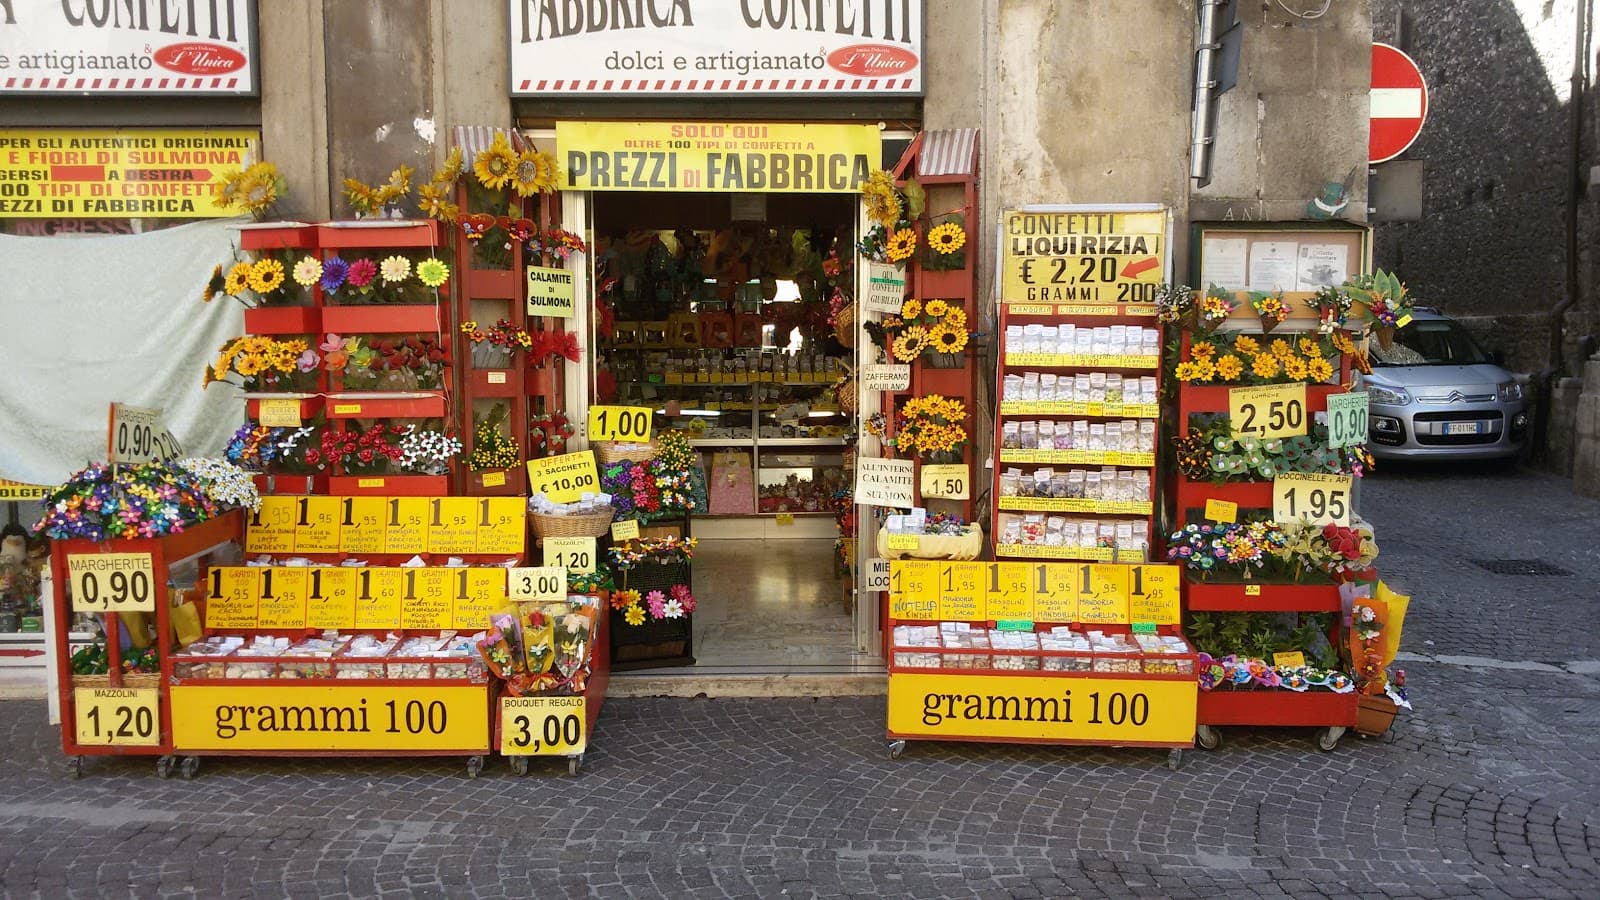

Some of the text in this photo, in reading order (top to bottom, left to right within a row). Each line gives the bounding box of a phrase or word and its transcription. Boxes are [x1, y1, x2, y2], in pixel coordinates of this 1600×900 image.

[18, 50, 153, 75] artigianato
[165, 50, 235, 68] L'Unica
[605, 50, 825, 75] dolci e artigianato
[839, 52, 906, 69] L'Unica
[671, 125, 768, 139] SOLO QUI
[0, 138, 249, 148] PER GLI AUTENTICI ORIGINALI
[624, 140, 815, 150] OLTRE 100 TIPI DI CONFETTI A
[9, 152, 241, 164] E FIORI DI SULMONA
[108, 170, 119, 180] A
[127, 169, 194, 181] DESTRA
[568, 151, 870, 189] PREZZI DI FABBRICA
[37, 184, 80, 196] TIPI
[90, 184, 111, 196] DI
[122, 184, 217, 196] CONFETT
[52, 200, 74, 212] DI
[84, 200, 194, 212] FABBRICA
[1010, 214, 1114, 234] CONFETTI
[1012, 236, 1148, 255] LIQUIRIZIA
[530, 271, 571, 285] CALAMITE
[1019, 257, 1117, 284] € 2,20
[530, 295, 571, 308] SULMONA
[870, 295, 900, 305] GIUBILEO
[1027, 283, 1156, 302] GRAMMI 200
[597, 410, 647, 440] 1,00
[1240, 399, 1302, 437] 2,50
[1334, 408, 1366, 440] 0,90
[118, 422, 151, 461] 0,90
[540, 453, 584, 468] OFFERTA
[545, 461, 590, 475] SACCHETTI
[540, 474, 593, 493] € 10,00
[862, 474, 913, 485] CALAMITE
[1278, 472, 1350, 484] COCCINELLE API
[932, 479, 963, 497] 1,50
[1283, 487, 1345, 520] 1,95
[70, 558, 150, 571] MARGHERITE
[555, 552, 588, 570] 1,20
[82, 570, 148, 610] 0,90
[522, 576, 559, 597] 3,00
[94, 688, 138, 698] MAZZOLINI
[504, 698, 584, 708] BOUQUET REGALO
[922, 689, 1149, 726] grammi 100
[87, 705, 153, 743] 1,20
[215, 698, 447, 739] grammi 100
[513, 714, 581, 753] 3,00
